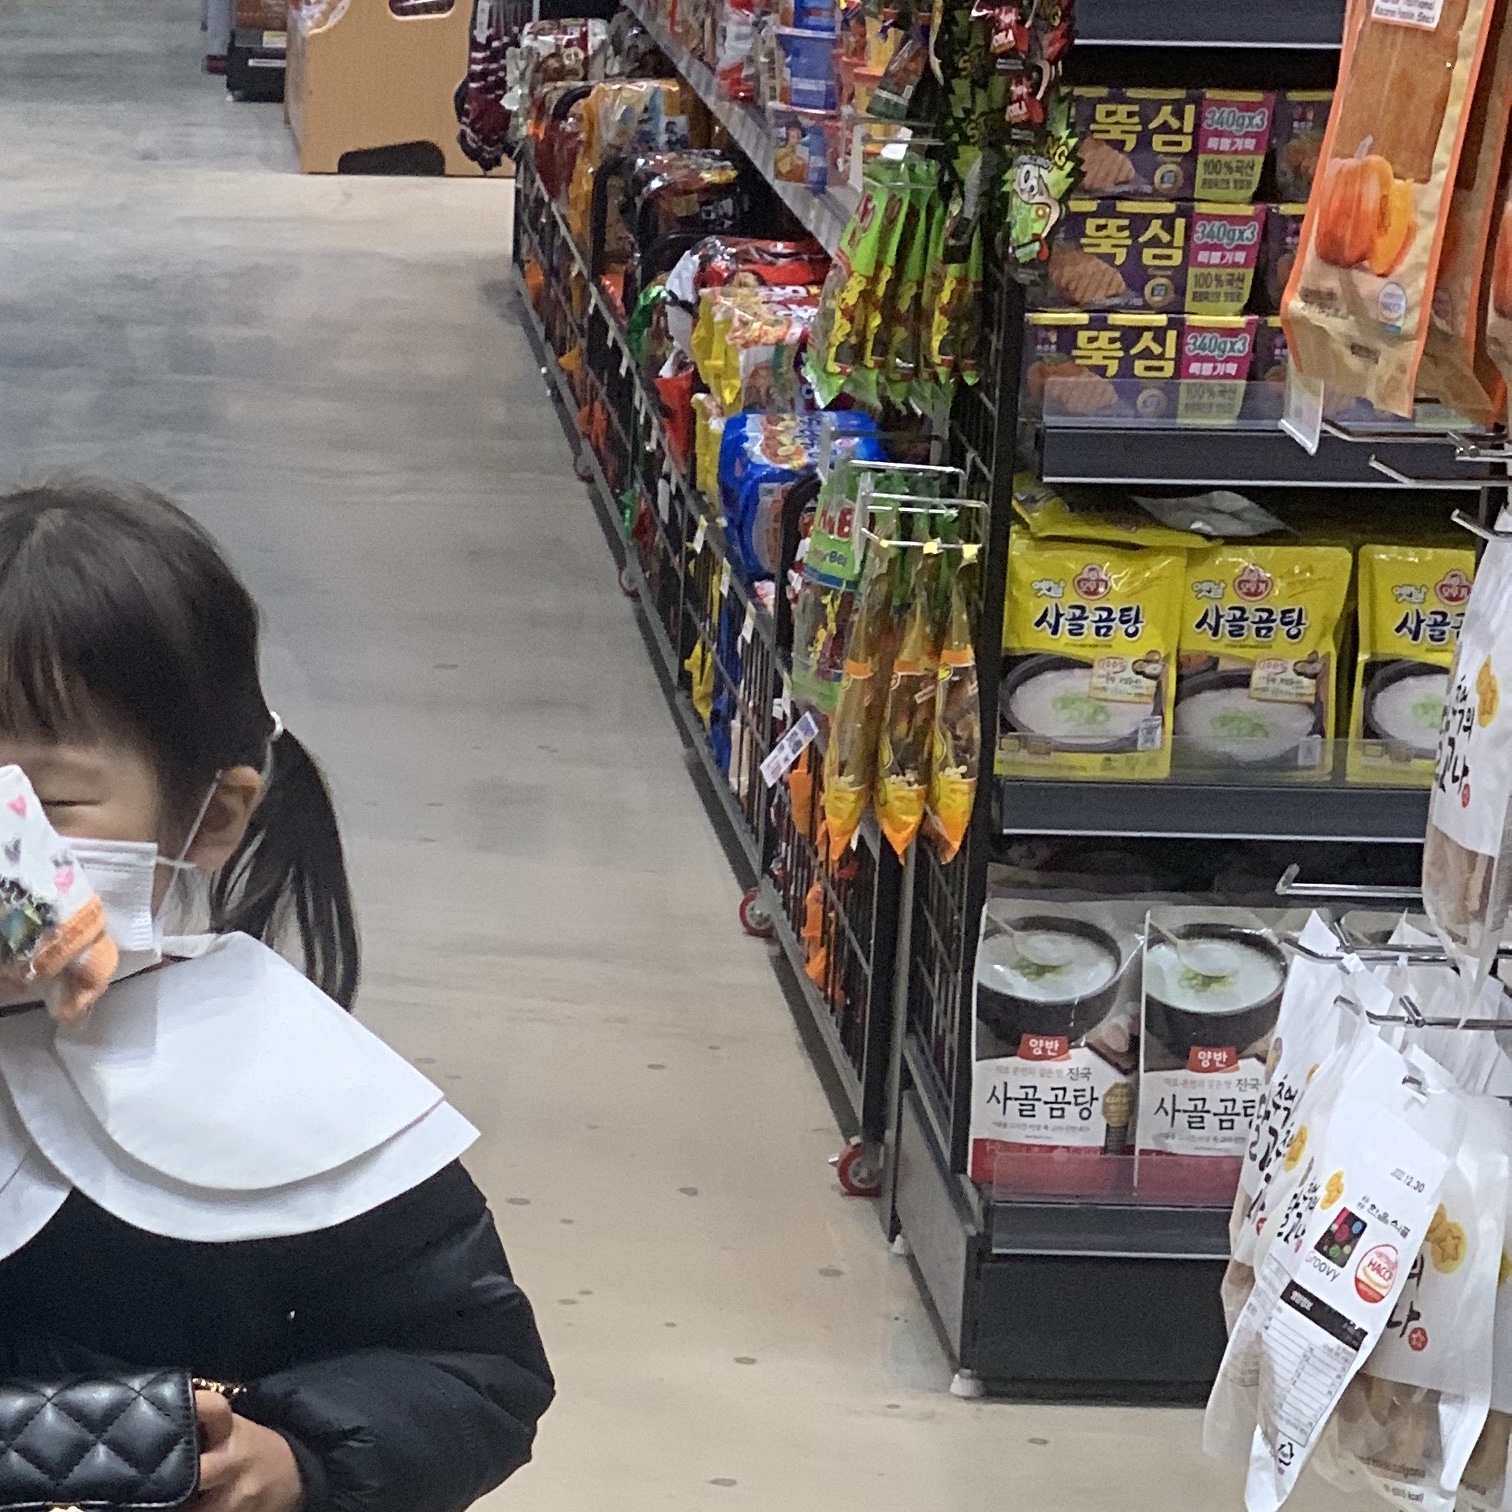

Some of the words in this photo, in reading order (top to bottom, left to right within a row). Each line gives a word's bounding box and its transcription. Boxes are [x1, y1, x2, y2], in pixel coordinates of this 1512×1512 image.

[1090, 104, 1196, 153] 뚝심
[1080, 217, 1186, 266] 뚝심
[1072, 330, 1178, 378] 뚝심
[1033, 602, 1144, 639] 사골곰탕
[1194, 604, 1307, 640] 사골곰탕
[1394, 608, 1465, 642] 사골
[1028, 1038, 1060, 1056] 양반
[1197, 1050, 1229, 1068] 양반
[986, 1081, 1099, 1121] 사골곰탕
[1304, 1249, 1341, 1283] Groovy
